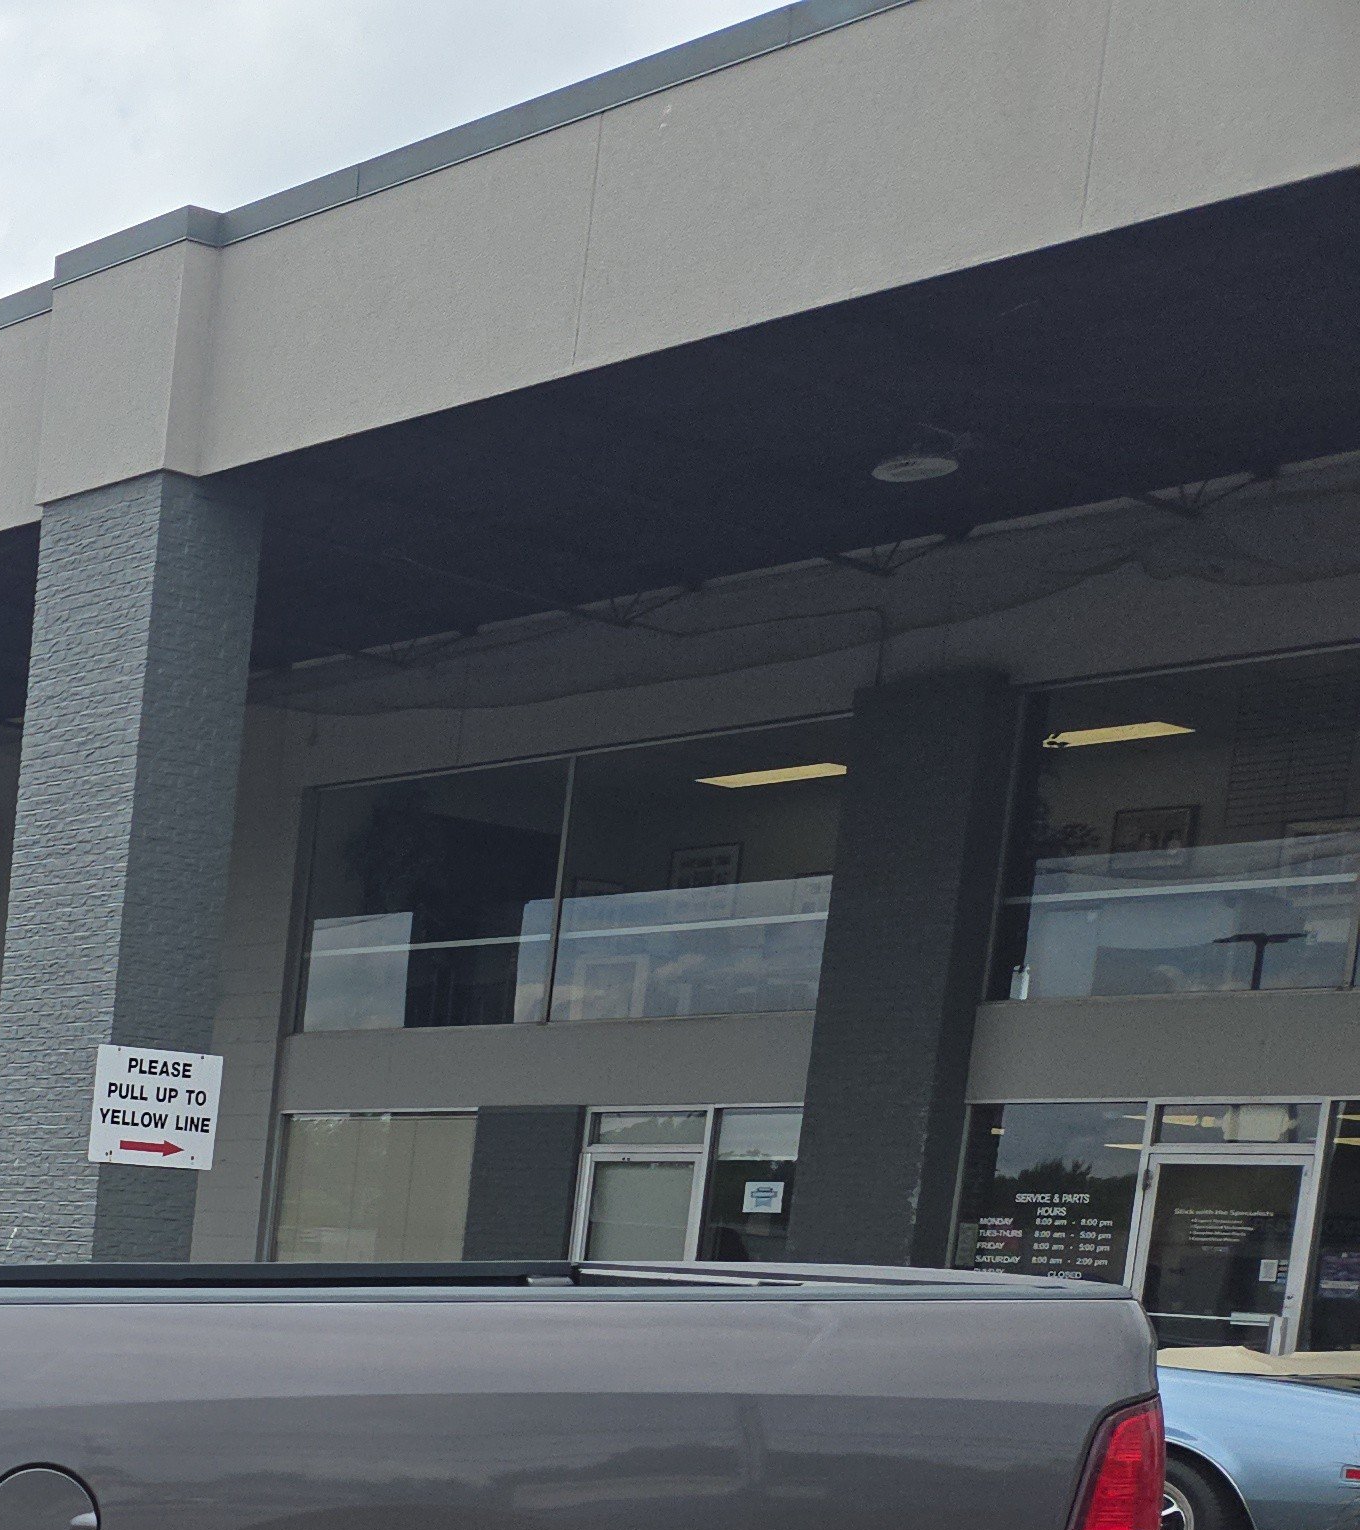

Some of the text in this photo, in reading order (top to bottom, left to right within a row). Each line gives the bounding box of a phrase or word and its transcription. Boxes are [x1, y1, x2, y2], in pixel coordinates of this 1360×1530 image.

[128, 1058, 192, 1078] PLEASE
[108, 1082, 207, 1106] PULL UP TO
[100, 1107, 211, 1133] YELLOW LINE
[1015, 1193, 1090, 1203] SERVICE & PARTS
[1037, 1206, 1067, 1216] HOURS
[980, 1217, 1014, 1225] MONDAY
[1099, 1220, 1113, 1228] pm
[979, 1229, 1023, 1237] TUES-THURS
[1034, 1230, 1051, 1238] 8:00
[1079, 1231, 1096, 1239] 5:00
[976, 1241, 1005, 1249] FRIDAY
[1033, 1242, 1049, 1250] 8:00
[1078, 1243, 1095, 1251] 5:00
[974, 1255, 1021, 1264] SATURDAY
[1075, 1257, 1093, 1265] 2:00
[1094, 1259, 1108, 1267] pm
[1047, 1270, 1082, 1279] CLOSED
